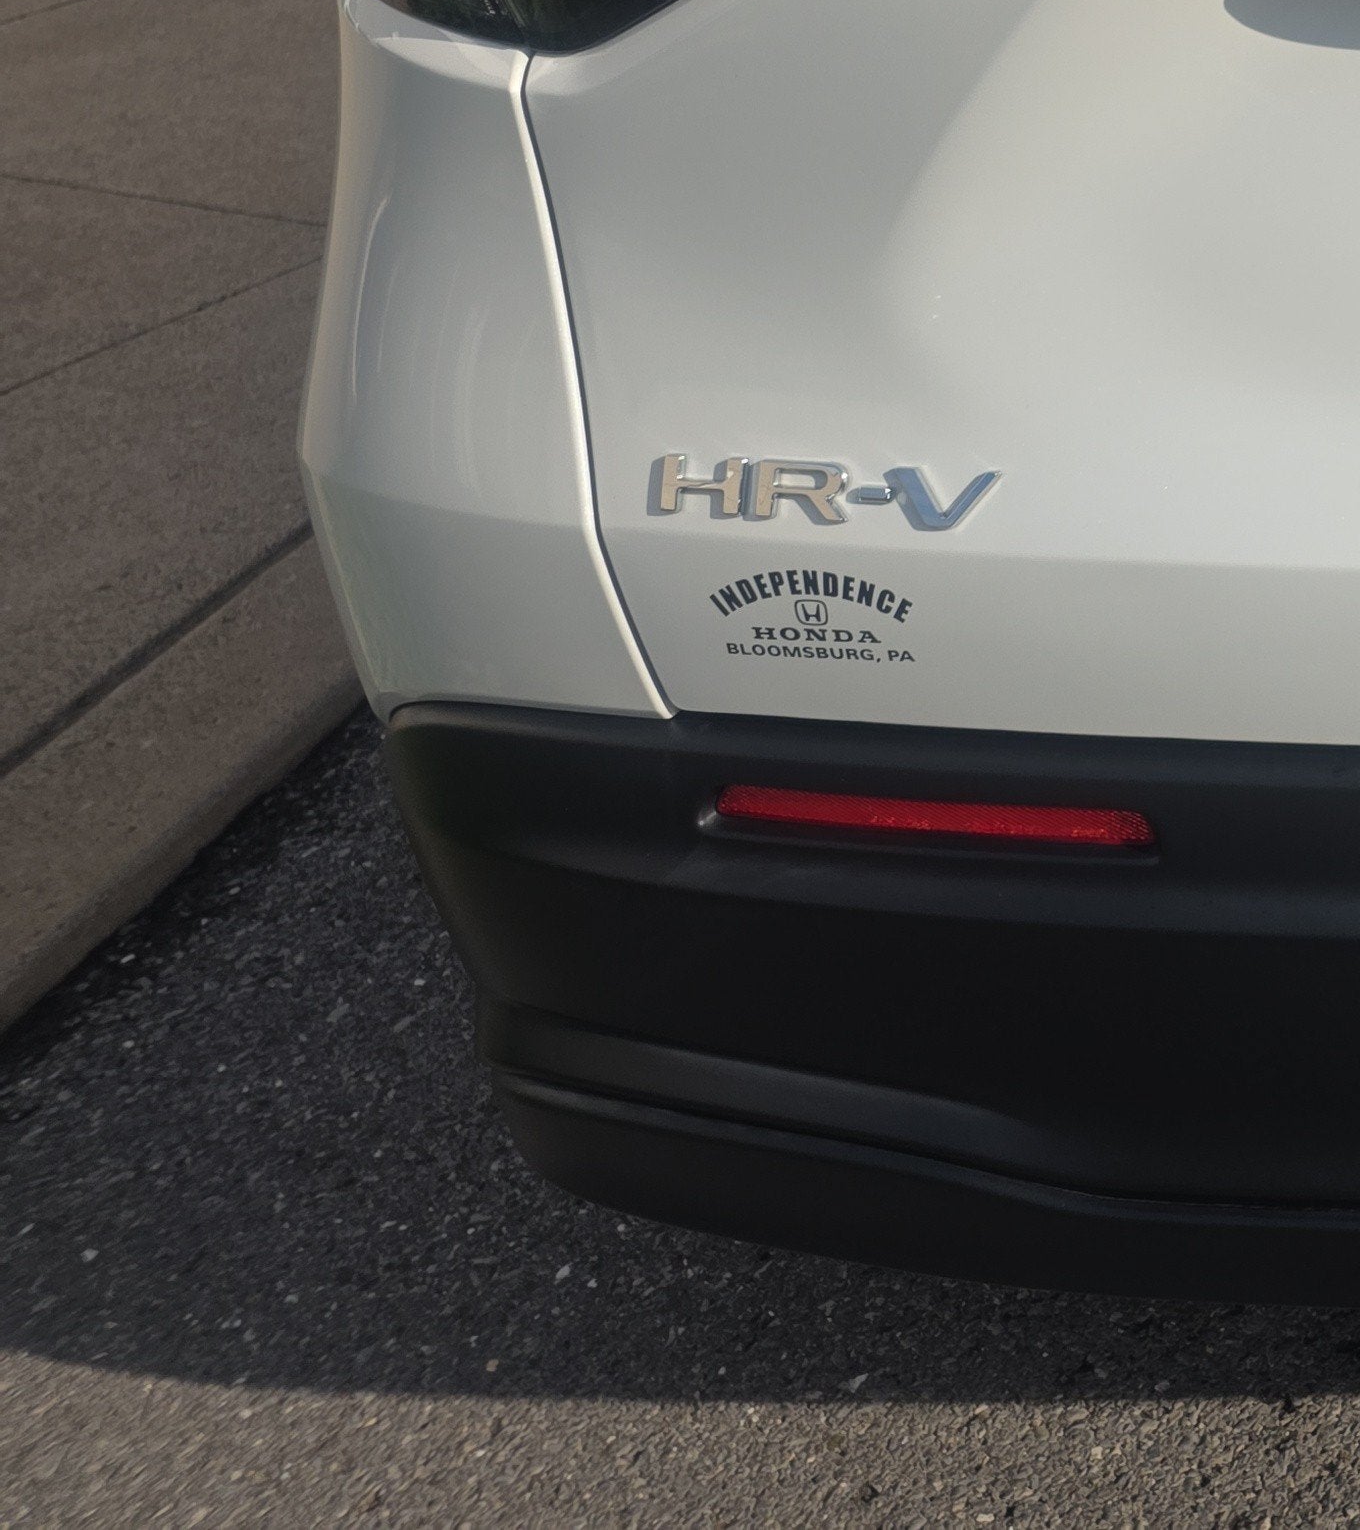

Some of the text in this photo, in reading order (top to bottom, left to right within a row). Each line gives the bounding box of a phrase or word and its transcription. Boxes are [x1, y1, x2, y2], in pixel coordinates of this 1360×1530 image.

[649, 453, 1002, 531] HR-V
[709, 569, 914, 624] INDEPENDENCE
[726, 643, 916, 663] BLOOMSBURG, PA
[752, 626, 882, 644] HONDA
